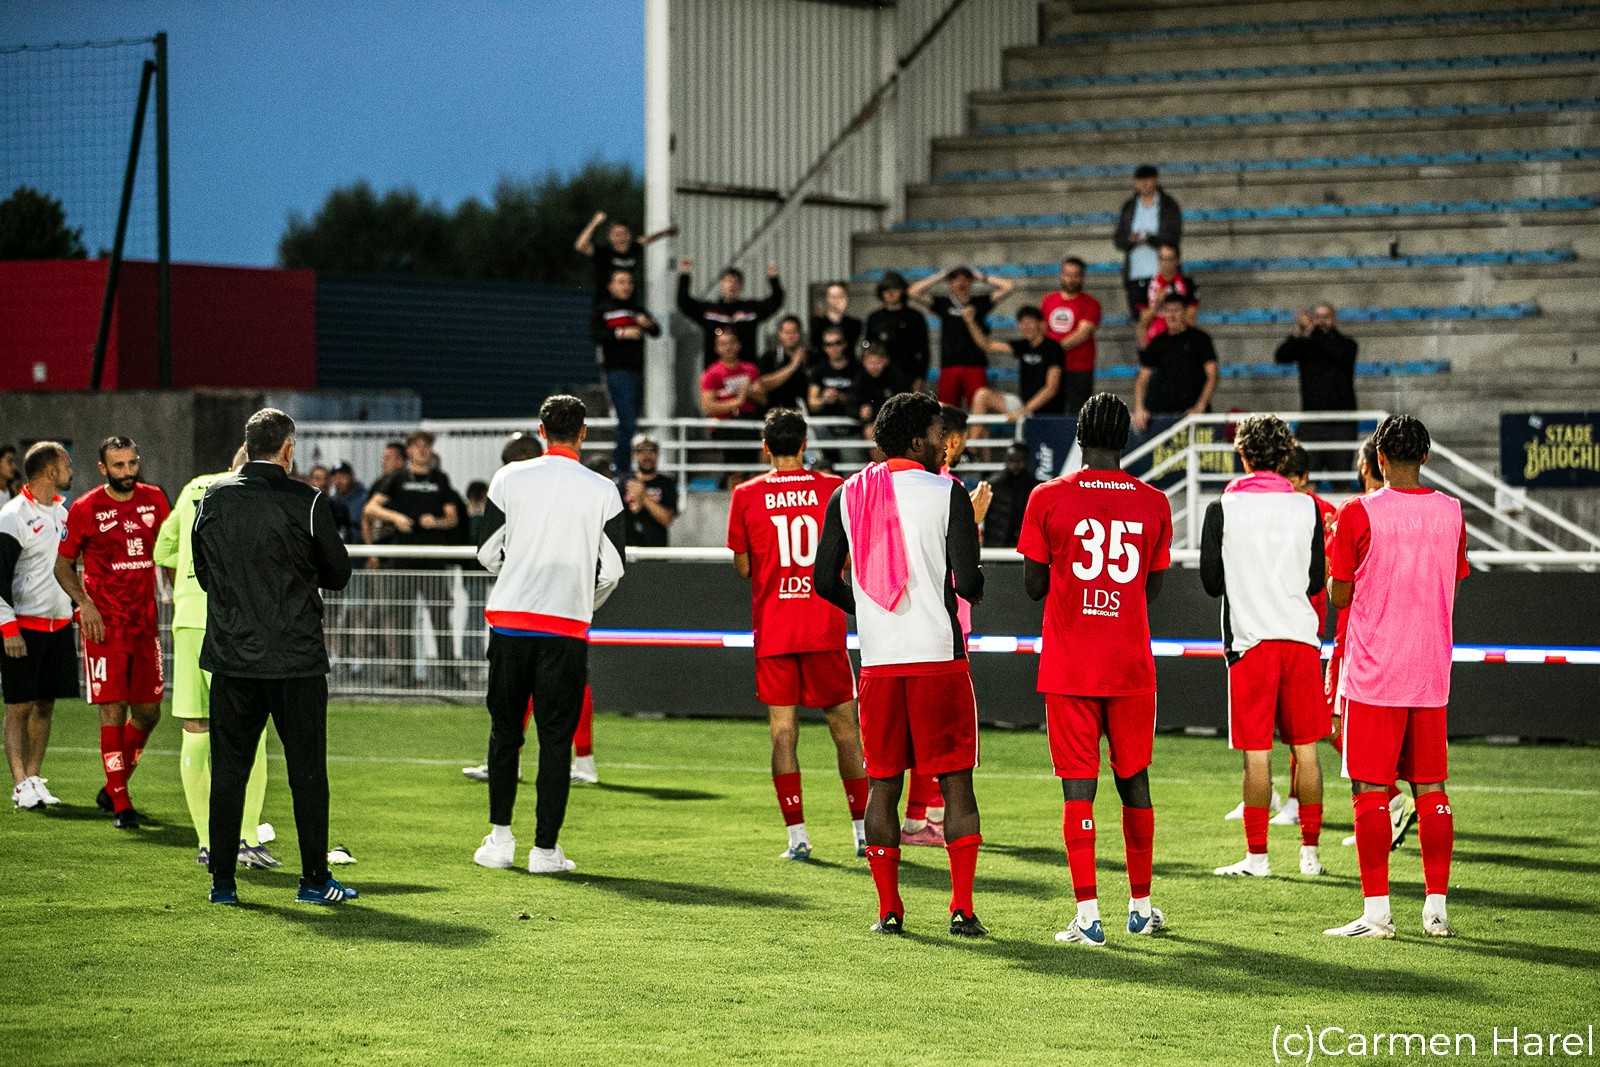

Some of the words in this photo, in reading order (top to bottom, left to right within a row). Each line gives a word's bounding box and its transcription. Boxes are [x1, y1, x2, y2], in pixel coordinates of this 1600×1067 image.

[1545, 424, 1592, 445] STADE
[764, 489, 819, 510] BARKA
[770, 514, 818, 567] 10
[1072, 518, 1143, 584] 35
[778, 575, 812, 593] LDS
[1083, 588, 1121, 611] LDS
[1097, 609, 1120, 618] GROUPE
[89, 657, 107, 682] 14
[786, 795, 800, 806] 10
[1436, 804, 1451, 814] 29
